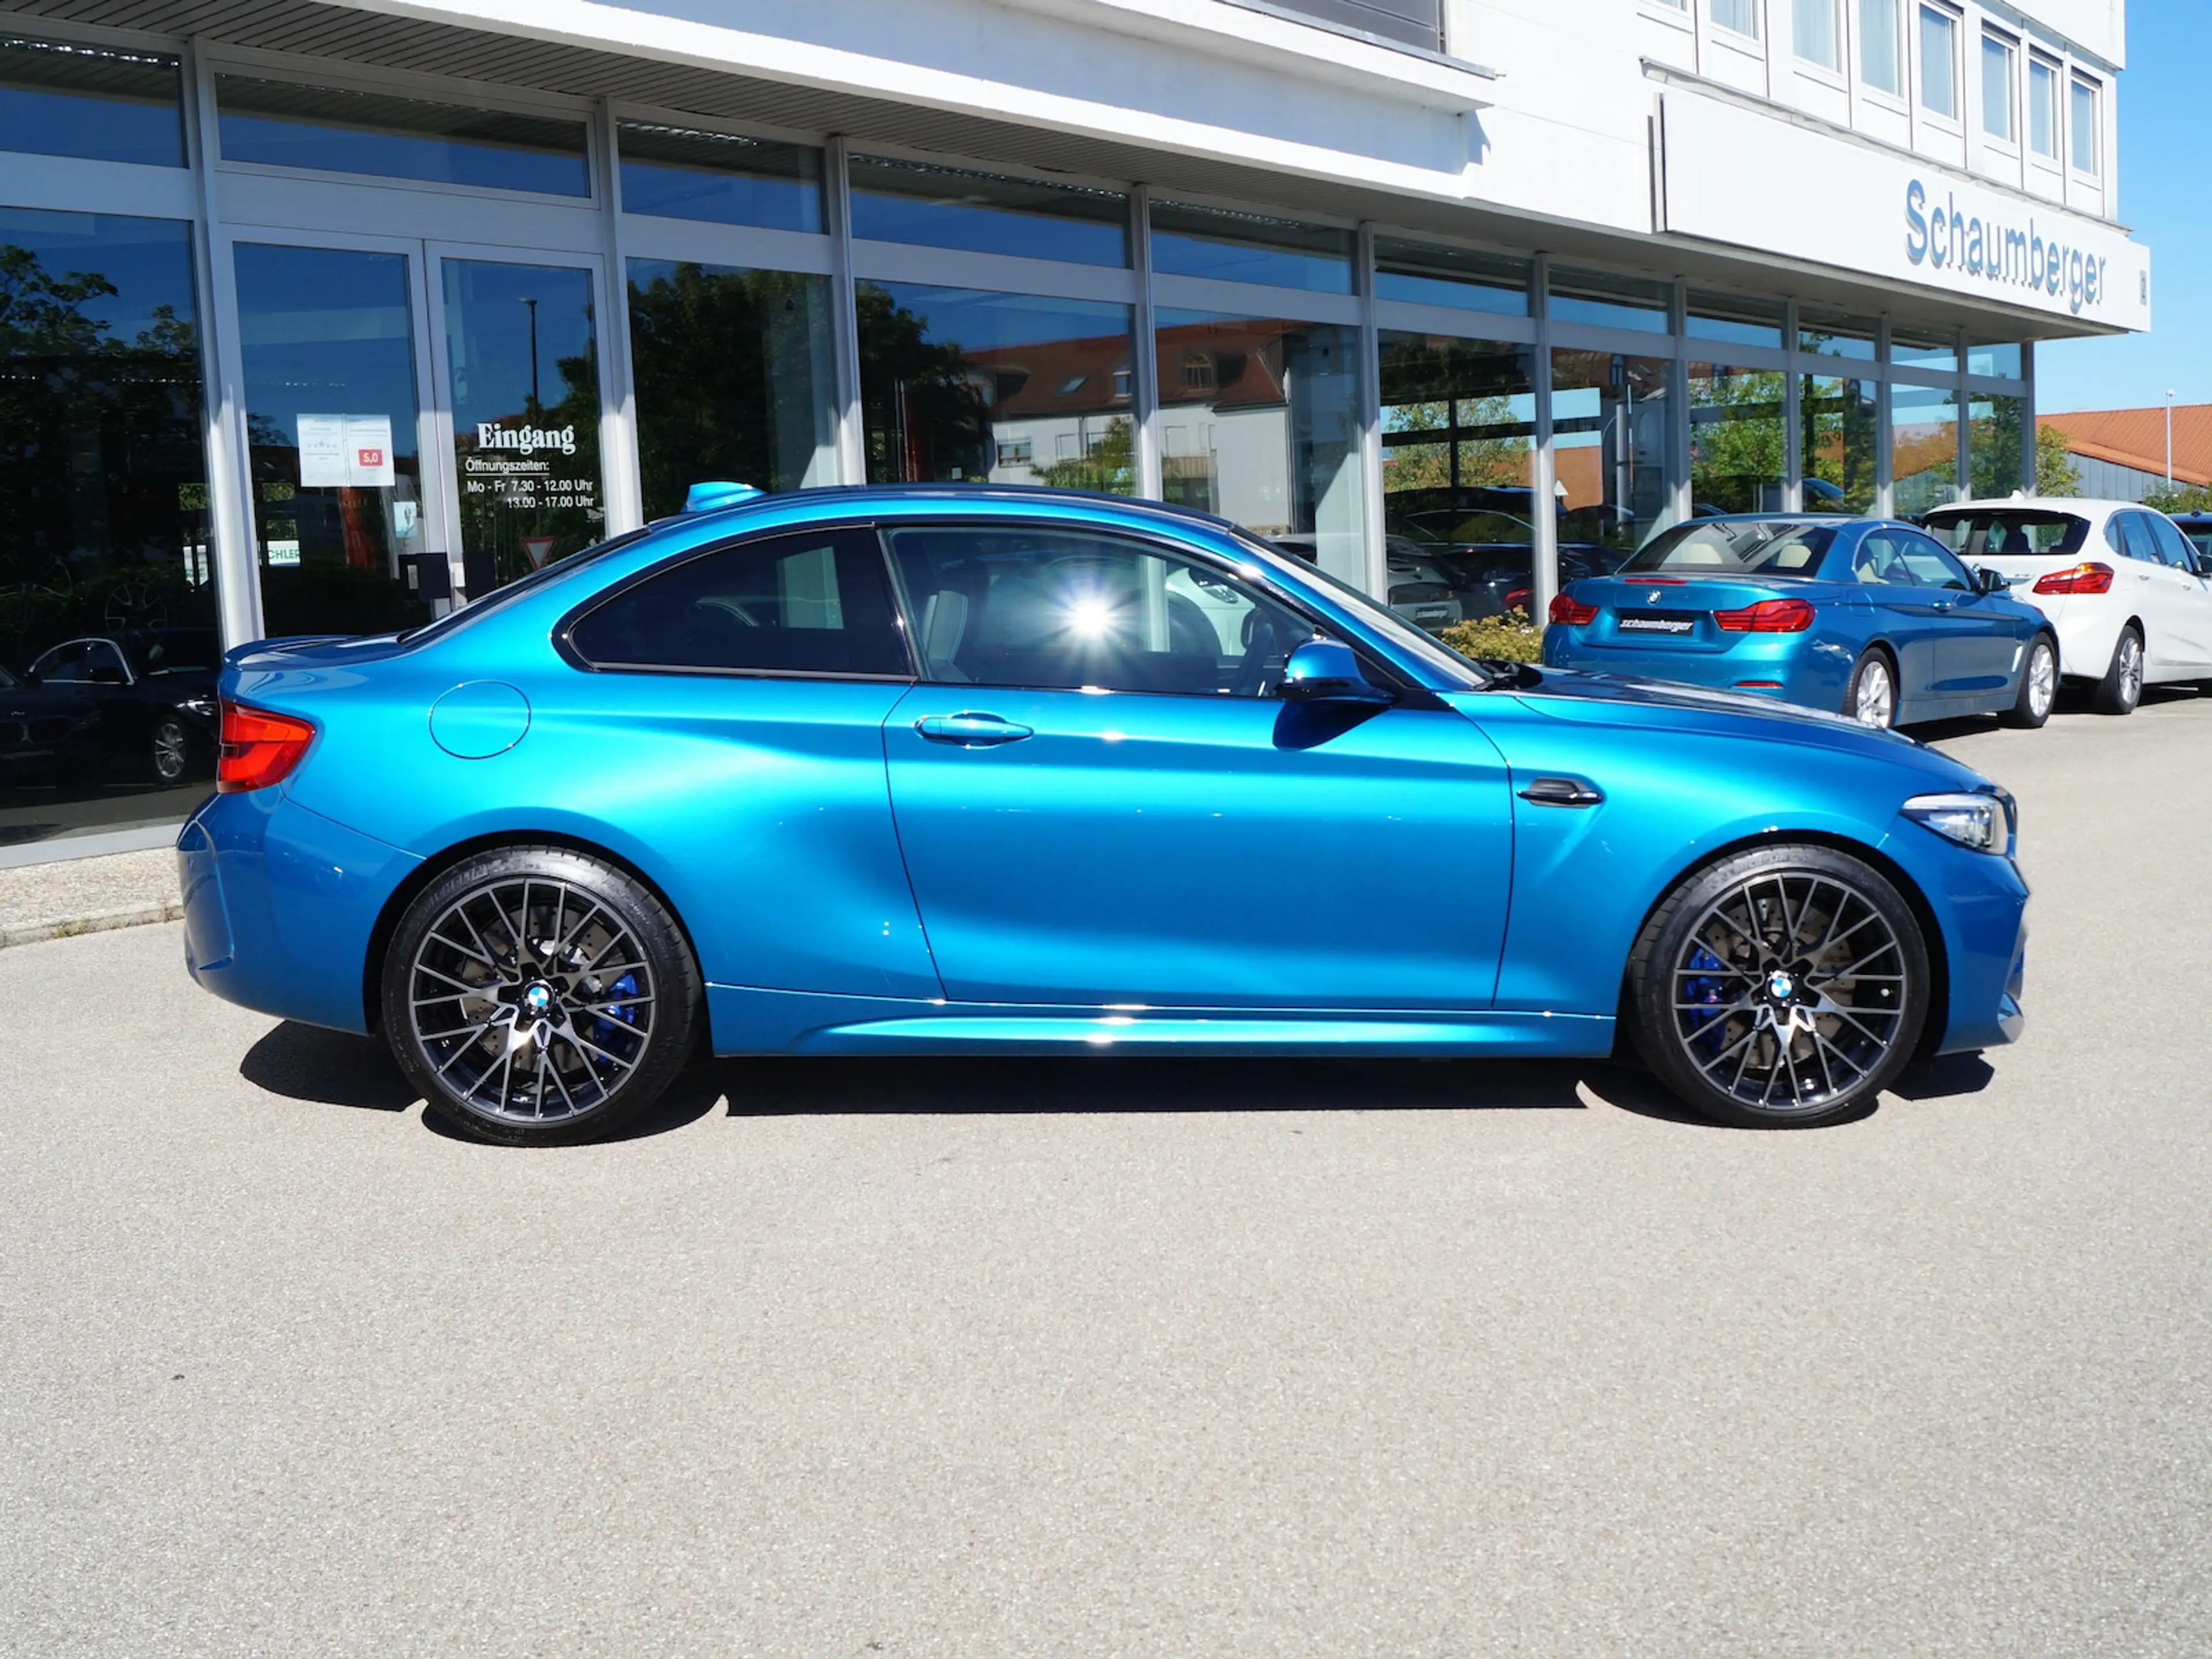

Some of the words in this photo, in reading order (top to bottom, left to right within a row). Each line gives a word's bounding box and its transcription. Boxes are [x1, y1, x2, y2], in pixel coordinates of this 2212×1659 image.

[1906, 179, 2106, 315] Schaumberger
[477, 423, 576, 455] Eingang
[465, 456, 550, 474] Öffnungszeiten:
[467, 480, 485, 493] Mo
[494, 480, 506, 492] Fr
[511, 480, 535, 492] 7.30
[545, 479, 573, 491] 12.00
[574, 479, 594, 491] Uhr
[507, 497, 536, 508] 13.00
[546, 496, 573, 507] 17.00
[575, 495, 594, 507] Uhr
